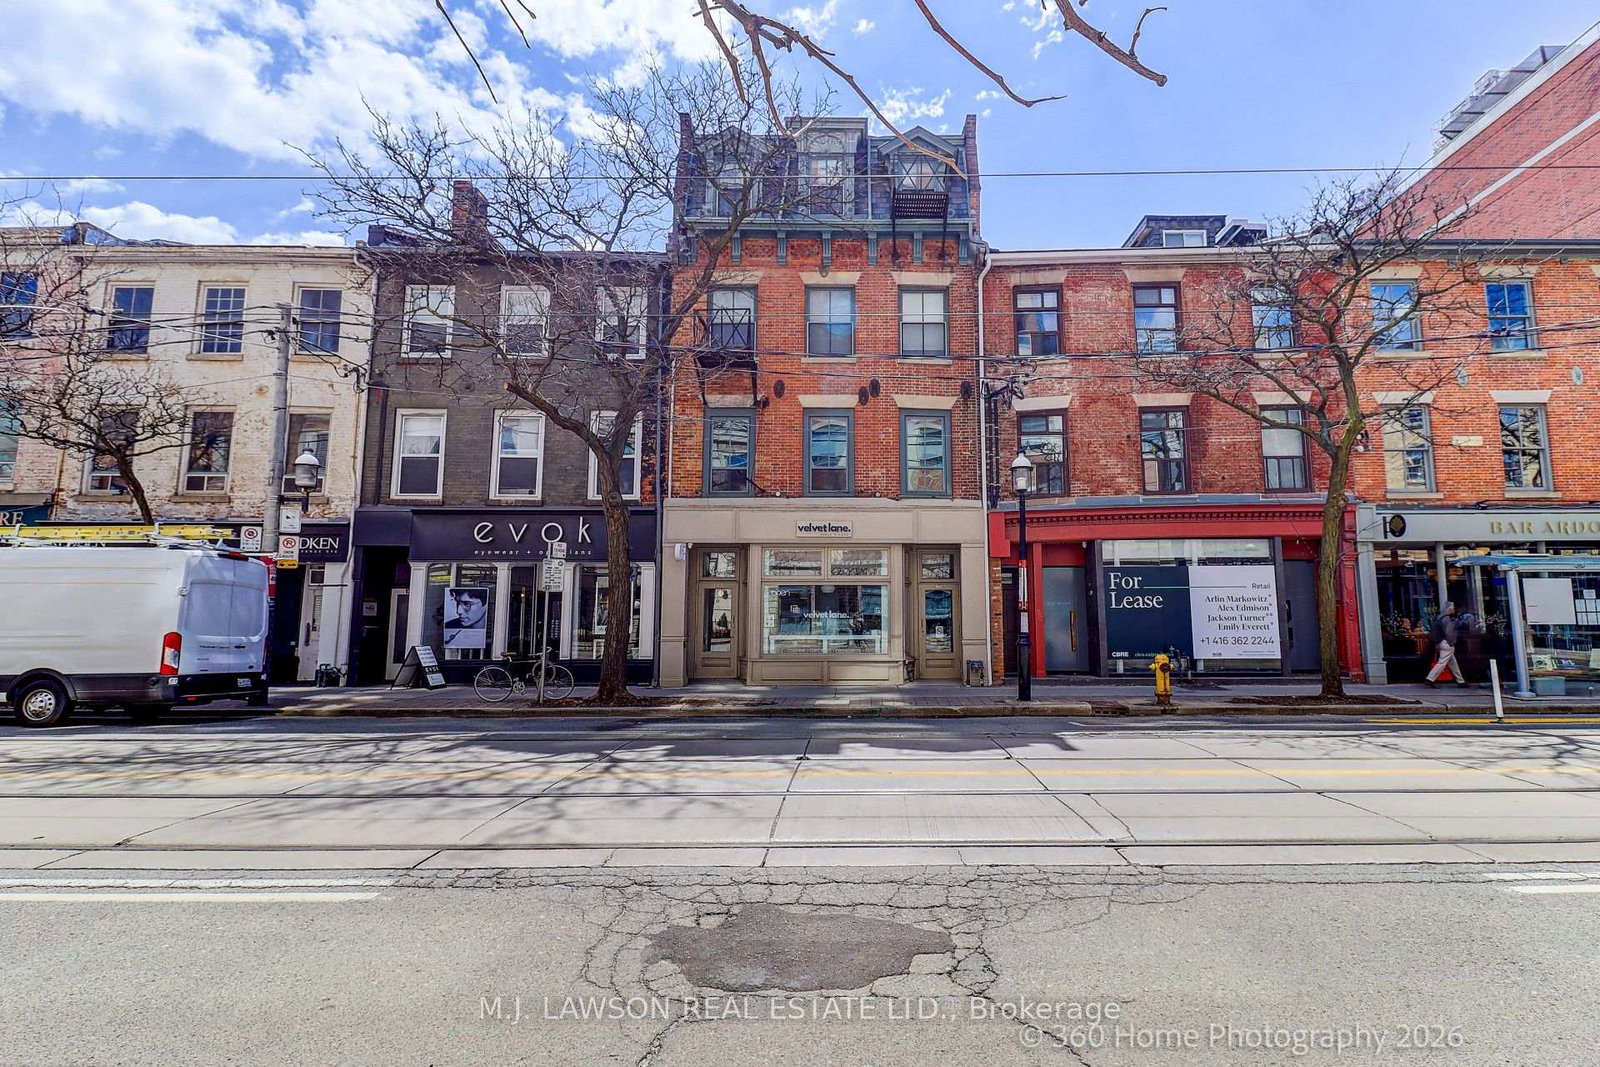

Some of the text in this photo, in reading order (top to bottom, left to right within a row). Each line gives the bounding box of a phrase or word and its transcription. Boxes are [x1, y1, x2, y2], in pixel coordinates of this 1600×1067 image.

[474, 516, 592, 543] evok
[797, 522, 851, 532] velvet lane.
[1490, 520, 1534, 534] BAR
[299, 537, 339, 549] DKEN
[1109, 572, 1142, 590] For
[1251, 582, 1271, 590] Retail
[1109, 591, 1164, 609] Lease
[1205, 595, 1225, 603] Arlin
[1217, 604, 1235, 612] Alex
[803, 610, 850, 619] velvet lane.
[1207, 614, 1237, 623] Jackson
[1218, 623, 1240, 633] Emily
[1200, 636, 1275, 645] +1 416 362 2244
